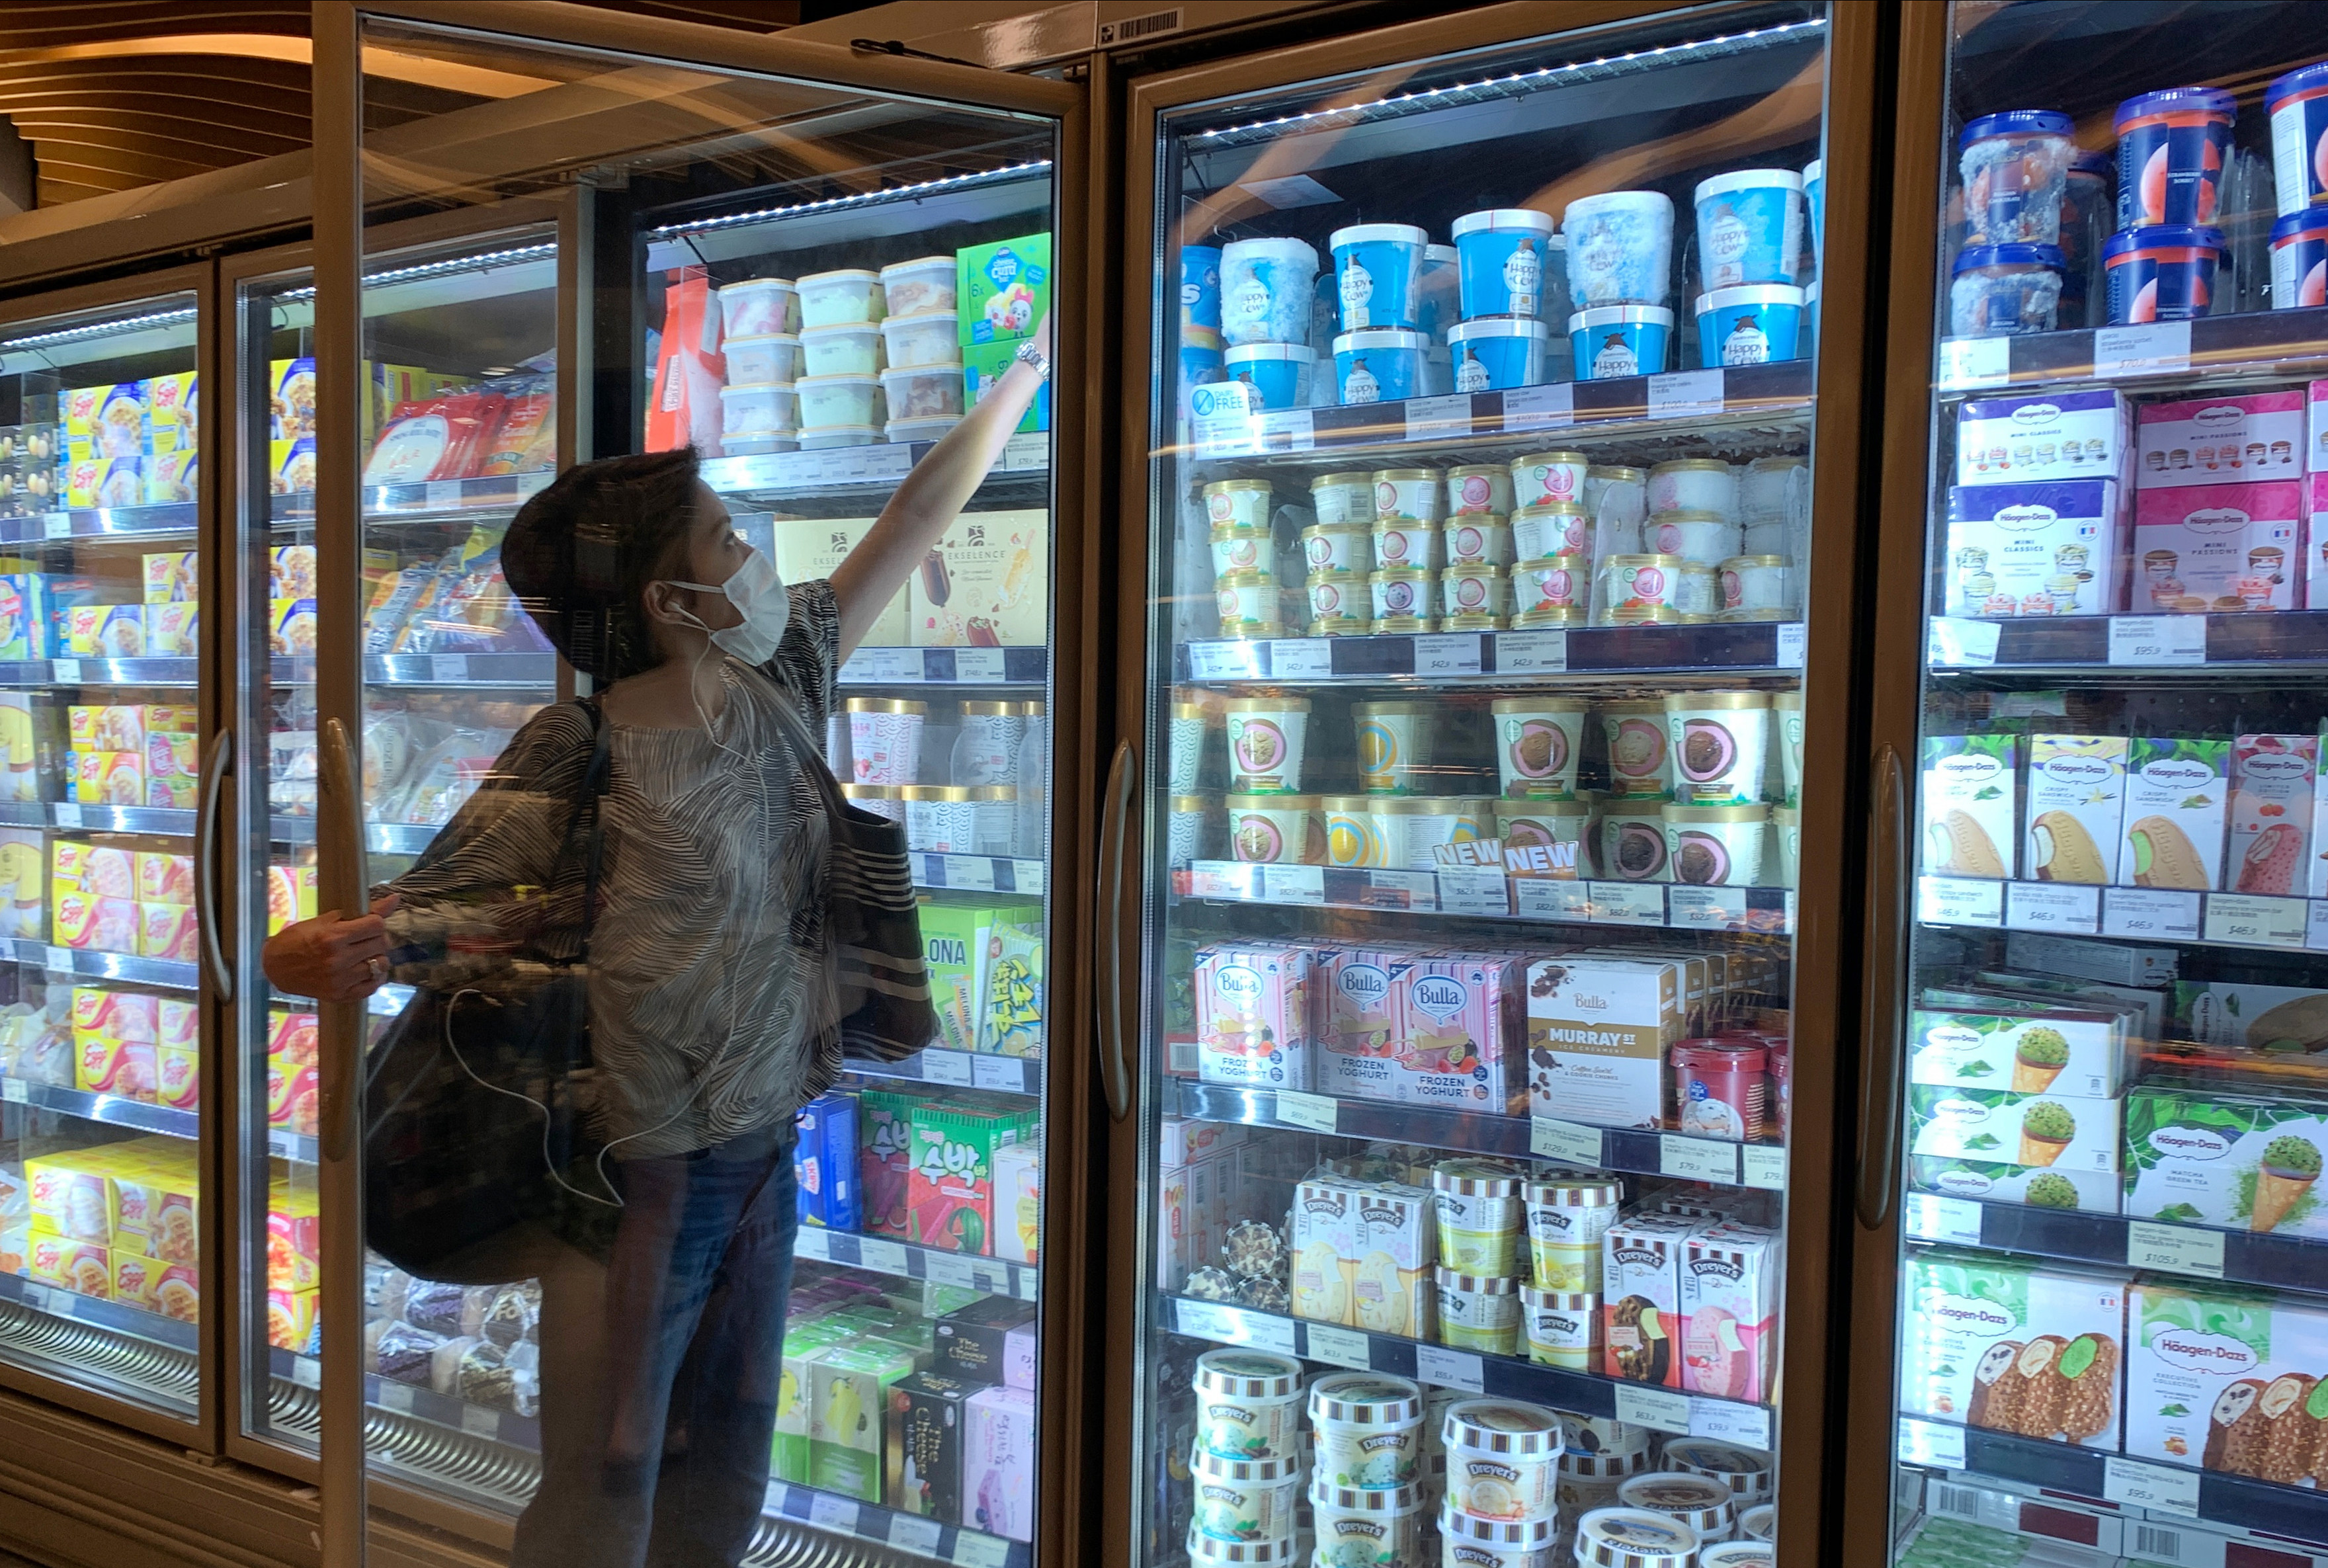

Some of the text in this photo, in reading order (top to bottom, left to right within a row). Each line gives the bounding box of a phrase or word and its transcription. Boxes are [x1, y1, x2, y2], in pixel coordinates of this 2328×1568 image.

[1728, 343, 1762, 357] Happy
[1599, 359, 1633, 374] Happy
[1346, 384, 1377, 397] Happy
[1216, 397, 1244, 410] FREE
[948, 550, 1007, 560] EKSELENCE
[2050, 763, 2106, 774] Häagen-Dazs
[2147, 767, 2208, 778] Häagen-Dazs
[2248, 761, 2305, 771] Häagen-Dazs
[1434, 839, 1501, 865] NEW
[1504, 842, 1576, 872] NEW
[1220, 973, 1257, 992] Bula
[1343, 971, 1382, 991] Bulla
[1419, 983, 1460, 1005] Bulla
[1573, 992, 1608, 1009] Bulla
[1549, 1028, 1636, 1047] MURRAY ST
[1579, 1046, 1626, 1054] CREAMERY
[1222, 1057, 1263, 1069] FROZN
[1342, 1058, 1385, 1070] FROZEN
[1337, 1066, 1388, 1080] YOGHURT
[1419, 1076, 1466, 1087] FROZEN
[1415, 1085, 1470, 1098] YOGHURT
[2156, 1134, 2223, 1151] Häagen-Dazs
[1307, 1200, 1345, 1217] Dreyer's
[1363, 1210, 1403, 1227] Dreyer's
[1616, 1249, 1661, 1269] Dreyer's
[2145, 1253, 2179, 1265] $105.9
[1692, 1260, 1739, 1280] Dreyer's
[2161, 1339, 2248, 1363] Häagen-Dazs
[2153, 1378, 2202, 1389] COLLECTION
[1210, 1406, 1253, 1424] Dreyer's
[1363, 1436, 1405, 1451] Dreyer's
[1470, 1462, 1519, 1481] Dreyer's
[1203, 1487, 1242, 1506] Dreyer's
[1338, 1522, 1382, 1539] Dreyer's
[1456, 1547, 1499, 1567] Dreyer's
